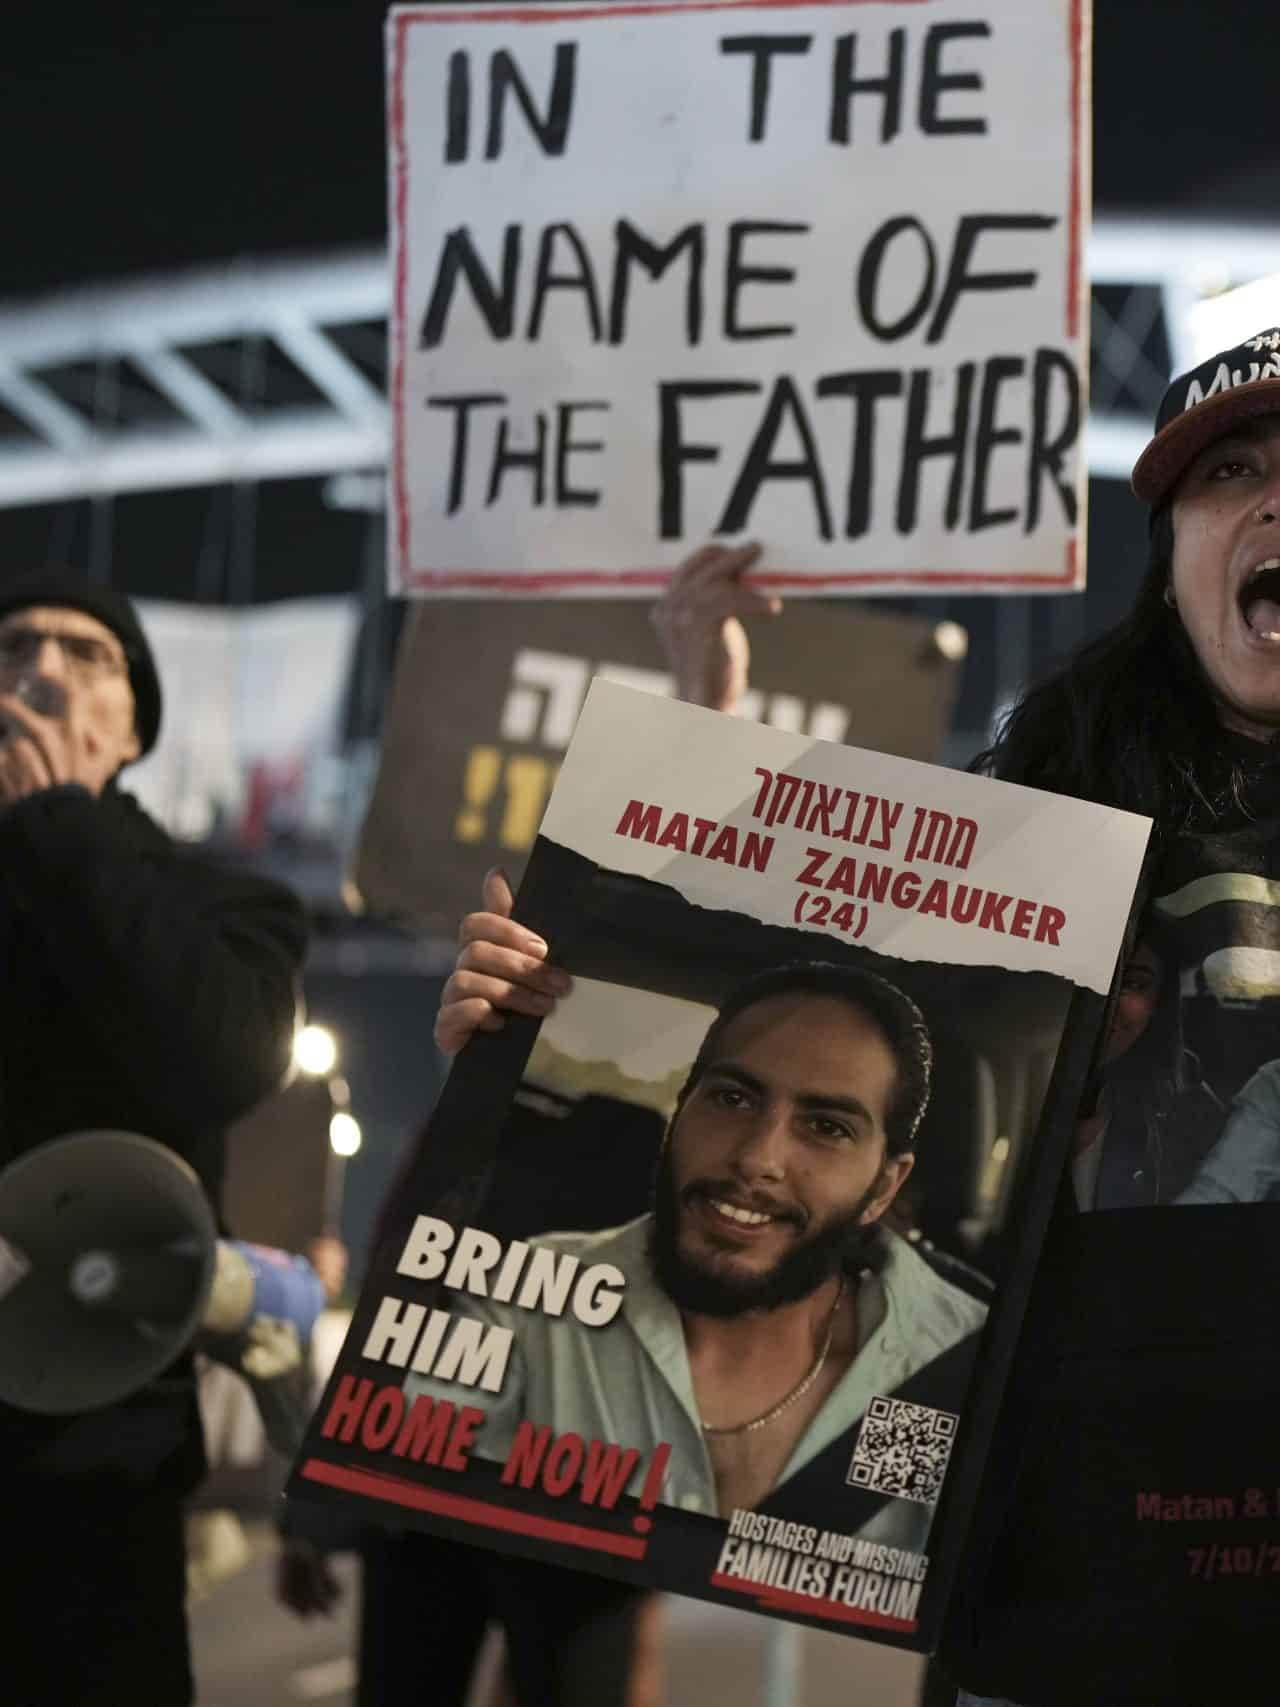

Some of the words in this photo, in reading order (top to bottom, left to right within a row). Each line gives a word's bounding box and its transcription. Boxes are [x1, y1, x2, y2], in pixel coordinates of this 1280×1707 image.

[444, 42, 577, 164] IN
[720, 21, 991, 145] THE
[418, 217, 811, 350] NAME
[856, 214, 1058, 344] OF
[426, 395, 610, 516] THE
[658, 348, 1081, 541] FATHER
[752, 767, 904, 850] צנגאוקר
[904, 806, 978, 869] מתן
[615, 800, 775, 872] MATAN
[795, 848, 1066, 946] ZANGAUKER
[794, 891, 869, 938] (24)
[396, 1214, 626, 1327] BRING
[362, 1296, 514, 1393] HIM
[321, 1375, 484, 1472] HOME
[729, 1509, 816, 1554] HOSTAGES
[817, 1530, 852, 1564] AND
[852, 1538, 928, 1581] MISSING
[1136, 1489, 1233, 1520] Matan
[1243, 1488, 1266, 1518] &
[717, 1537, 830, 1600] FAMILIES
[830, 1565, 922, 1621] FORUM
